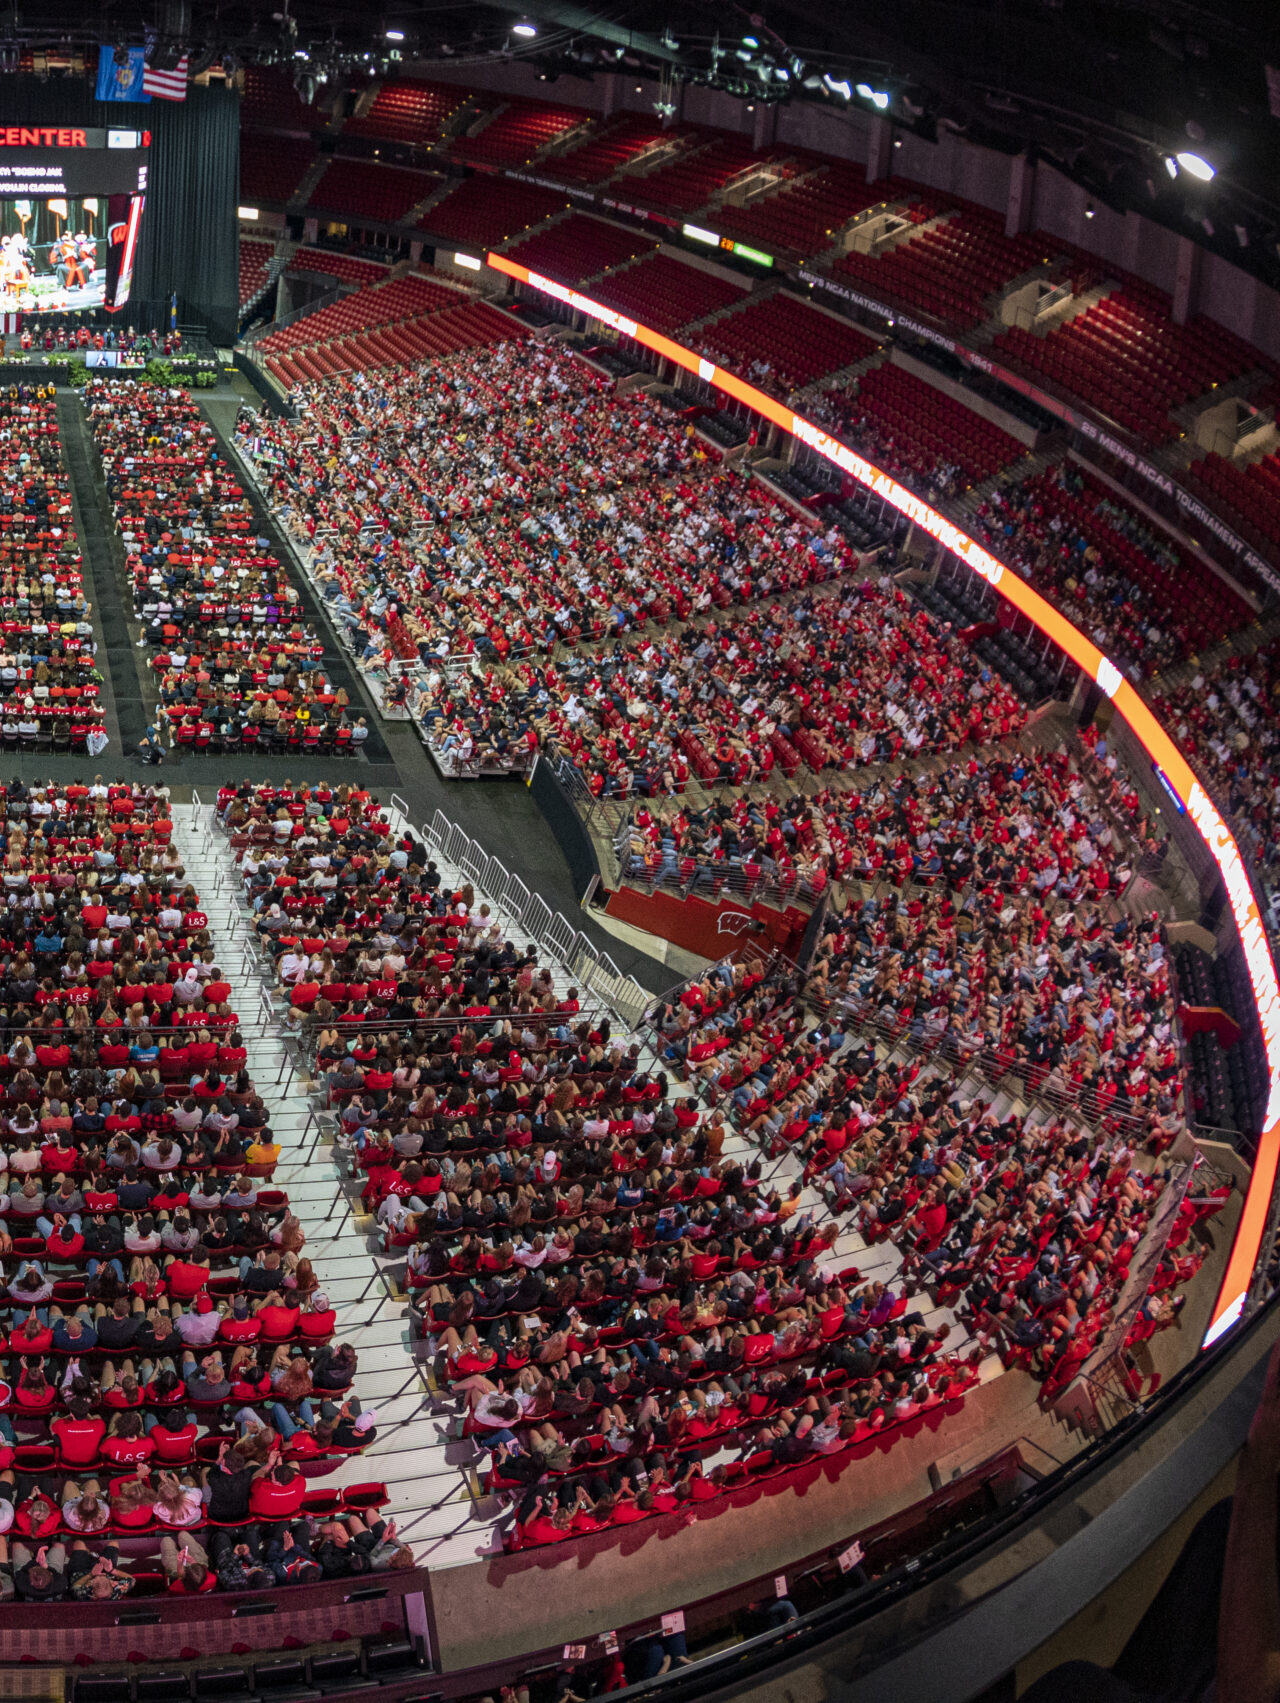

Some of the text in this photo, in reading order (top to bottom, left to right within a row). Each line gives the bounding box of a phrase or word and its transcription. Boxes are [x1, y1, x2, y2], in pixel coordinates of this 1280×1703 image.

[799, 270, 993, 373] MEN'S NCAA NATIONAL CHAMPIONS 1941
[1081, 421, 1098, 438] 25
[1098, 433, 1136, 468] MEN'S
[1136, 462, 1173, 495] NCAA
[1175, 489, 1244, 553] TOURNAMENT
[188, 917, 205, 926] L&S
[70, 992, 88, 1001] L&S
[377, 987, 394, 996] L&S
[388, 1182, 412, 1195] L&S
[115, 1451, 147, 1463] L&S
